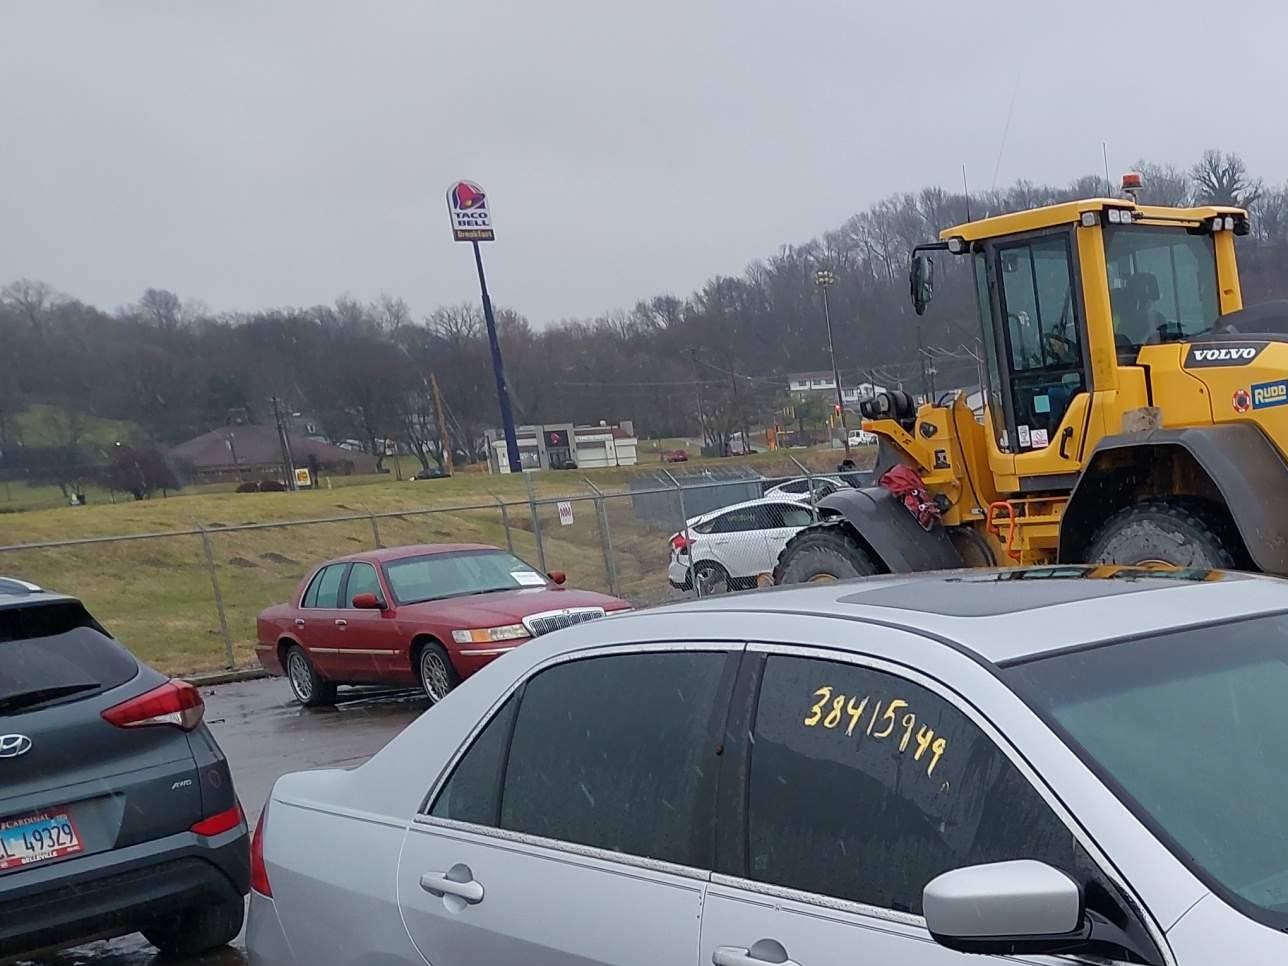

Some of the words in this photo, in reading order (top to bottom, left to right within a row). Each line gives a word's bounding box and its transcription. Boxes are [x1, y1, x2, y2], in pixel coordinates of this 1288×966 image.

[1194, 348, 1256, 361] VOLVO
[804, 687, 947, 779] 38415949
[171, 779, 192, 790] AWD
[23, 823, 74, 852] 49329
